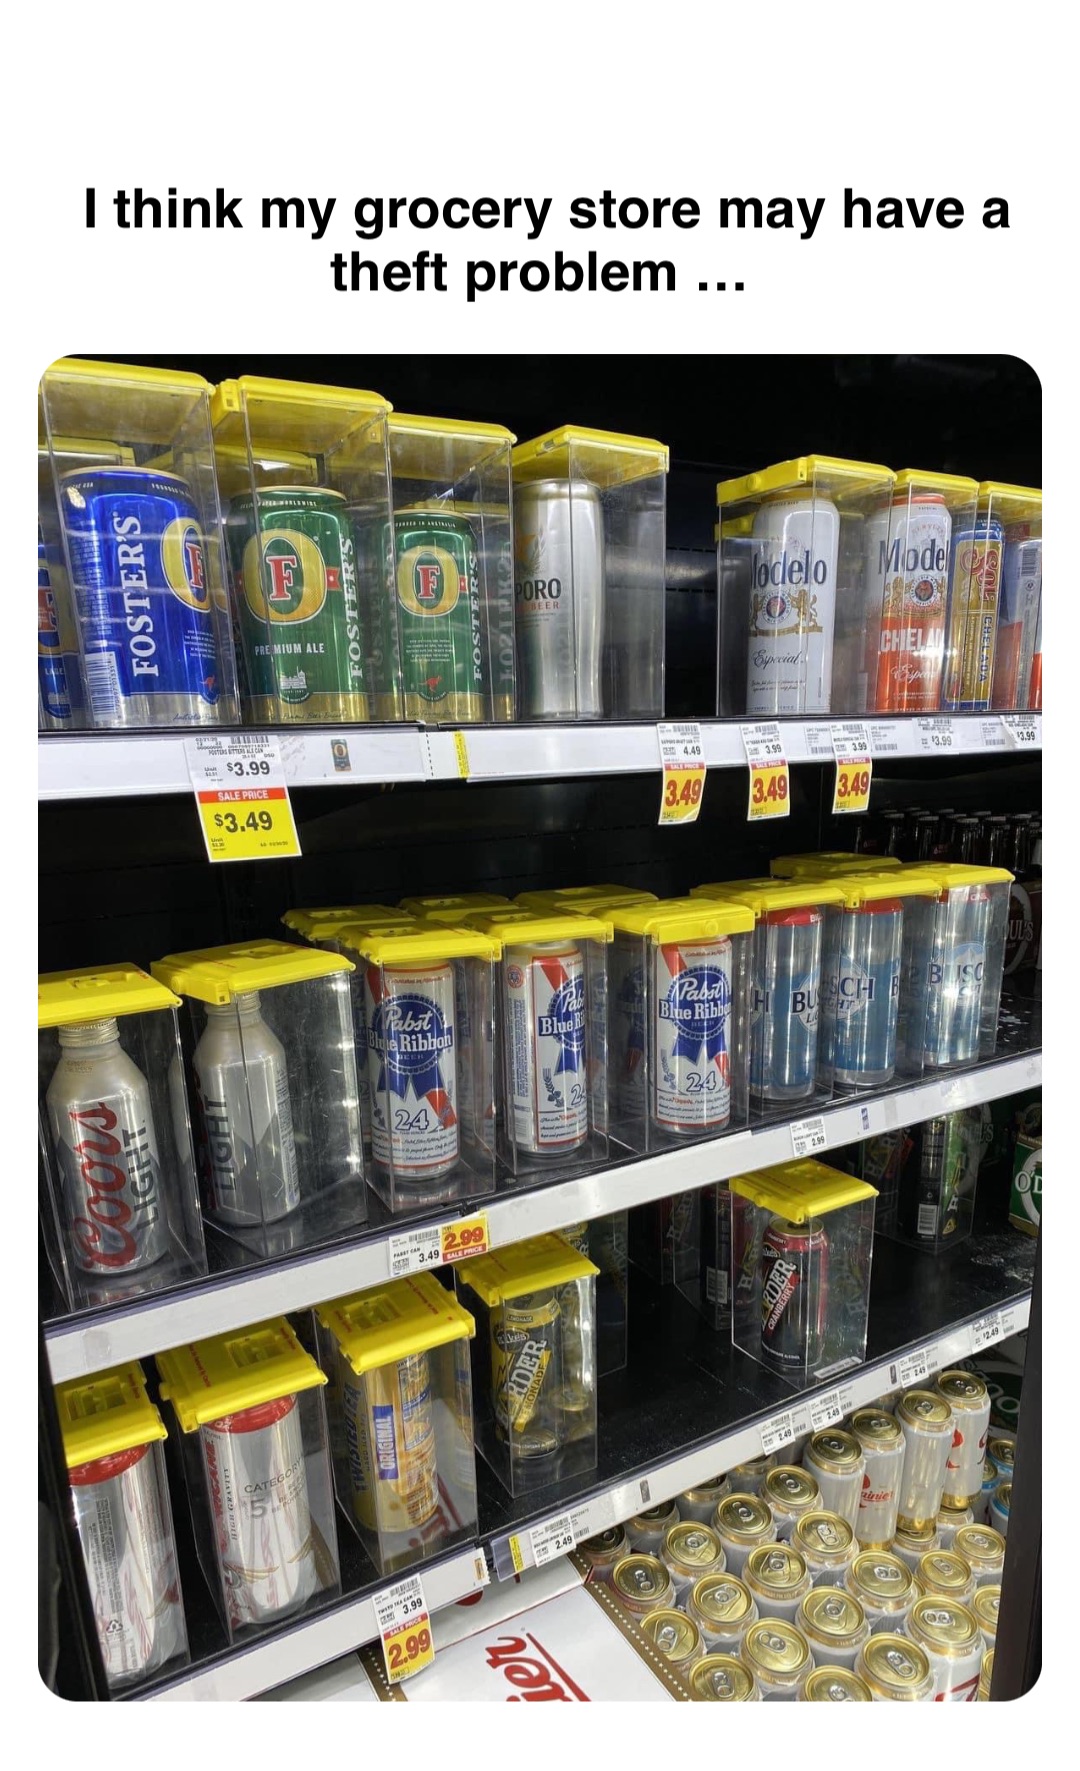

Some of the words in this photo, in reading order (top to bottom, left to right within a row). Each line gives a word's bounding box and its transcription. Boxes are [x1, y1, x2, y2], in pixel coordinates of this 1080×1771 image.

[266, 554, 298, 601] F
[417, 565, 440, 598] F
[113, 514, 158, 677] FOSTER'S
[338, 533, 363, 679] FOSTER'S
[469, 550, 482, 681] FOSTER'S
[254, 643, 302, 656] PREMIUM
[305, 643, 325, 655] ALE
[978, 616, 993, 683] CHELADA
[852, 741, 868, 752] 3.99
[931, 734, 952, 746] $3.99
[1016, 731, 1036, 742] $3.99
[683, 745, 701, 756] 4.49
[765, 743, 782, 755] 3.99
[226, 760, 270, 777] $3.99
[686, 762, 700, 770] PRICE
[665, 778, 703, 807] 3.49
[753, 774, 787, 804] 3.49
[836, 770, 869, 798] 3.49
[217, 791, 241, 801] SALE
[242, 789, 269, 800] PRICE
[213, 810, 273, 834] $3.49
[678, 977, 722, 1002] Pabst
[384, 1003, 433, 1032] Pabst
[659, 1000, 692, 1020] Blue
[541, 1016, 574, 1035] Blue
[369, 1029, 398, 1051] Blue
[399, 1032, 452, 1052] Ribbon
[686, 1071, 716, 1092] 24
[395, 1108, 430, 1131] 24
[811, 1135, 825, 1147] 2.99
[68, 1101, 138, 1269] Coors
[123, 1127, 160, 1231] LIGHT
[444, 1226, 484, 1251] 2.99
[393, 1249, 409, 1258] PABST
[418, 1249, 440, 1263] 3.49
[446, 1252, 463, 1261] SALE
[463, 1246, 483, 1256] PRICE
[767, 1282, 796, 1331] CRANBERRY
[982, 1326, 999, 1340] $2.49
[914, 1366, 926, 1376] 2.49
[827, 1407, 840, 1420] 2.49
[375, 1415, 396, 1471] ORIGINAL
[779, 1428, 792, 1441] 2.49
[244, 1456, 302, 1494] CATEGORY
[223, 1467, 234, 1512] GRAVITY
[861, 1490, 894, 1501] ainier
[249, 1497, 268, 1519] 5
[228, 1513, 238, 1541] HIGH
[555, 1535, 573, 1550] 2.49
[402, 1598, 423, 1615] 3.99
[389, 1625, 405, 1637] SALE
[405, 1617, 423, 1629] PRICE
[388, 1628, 431, 1670] 2.99
